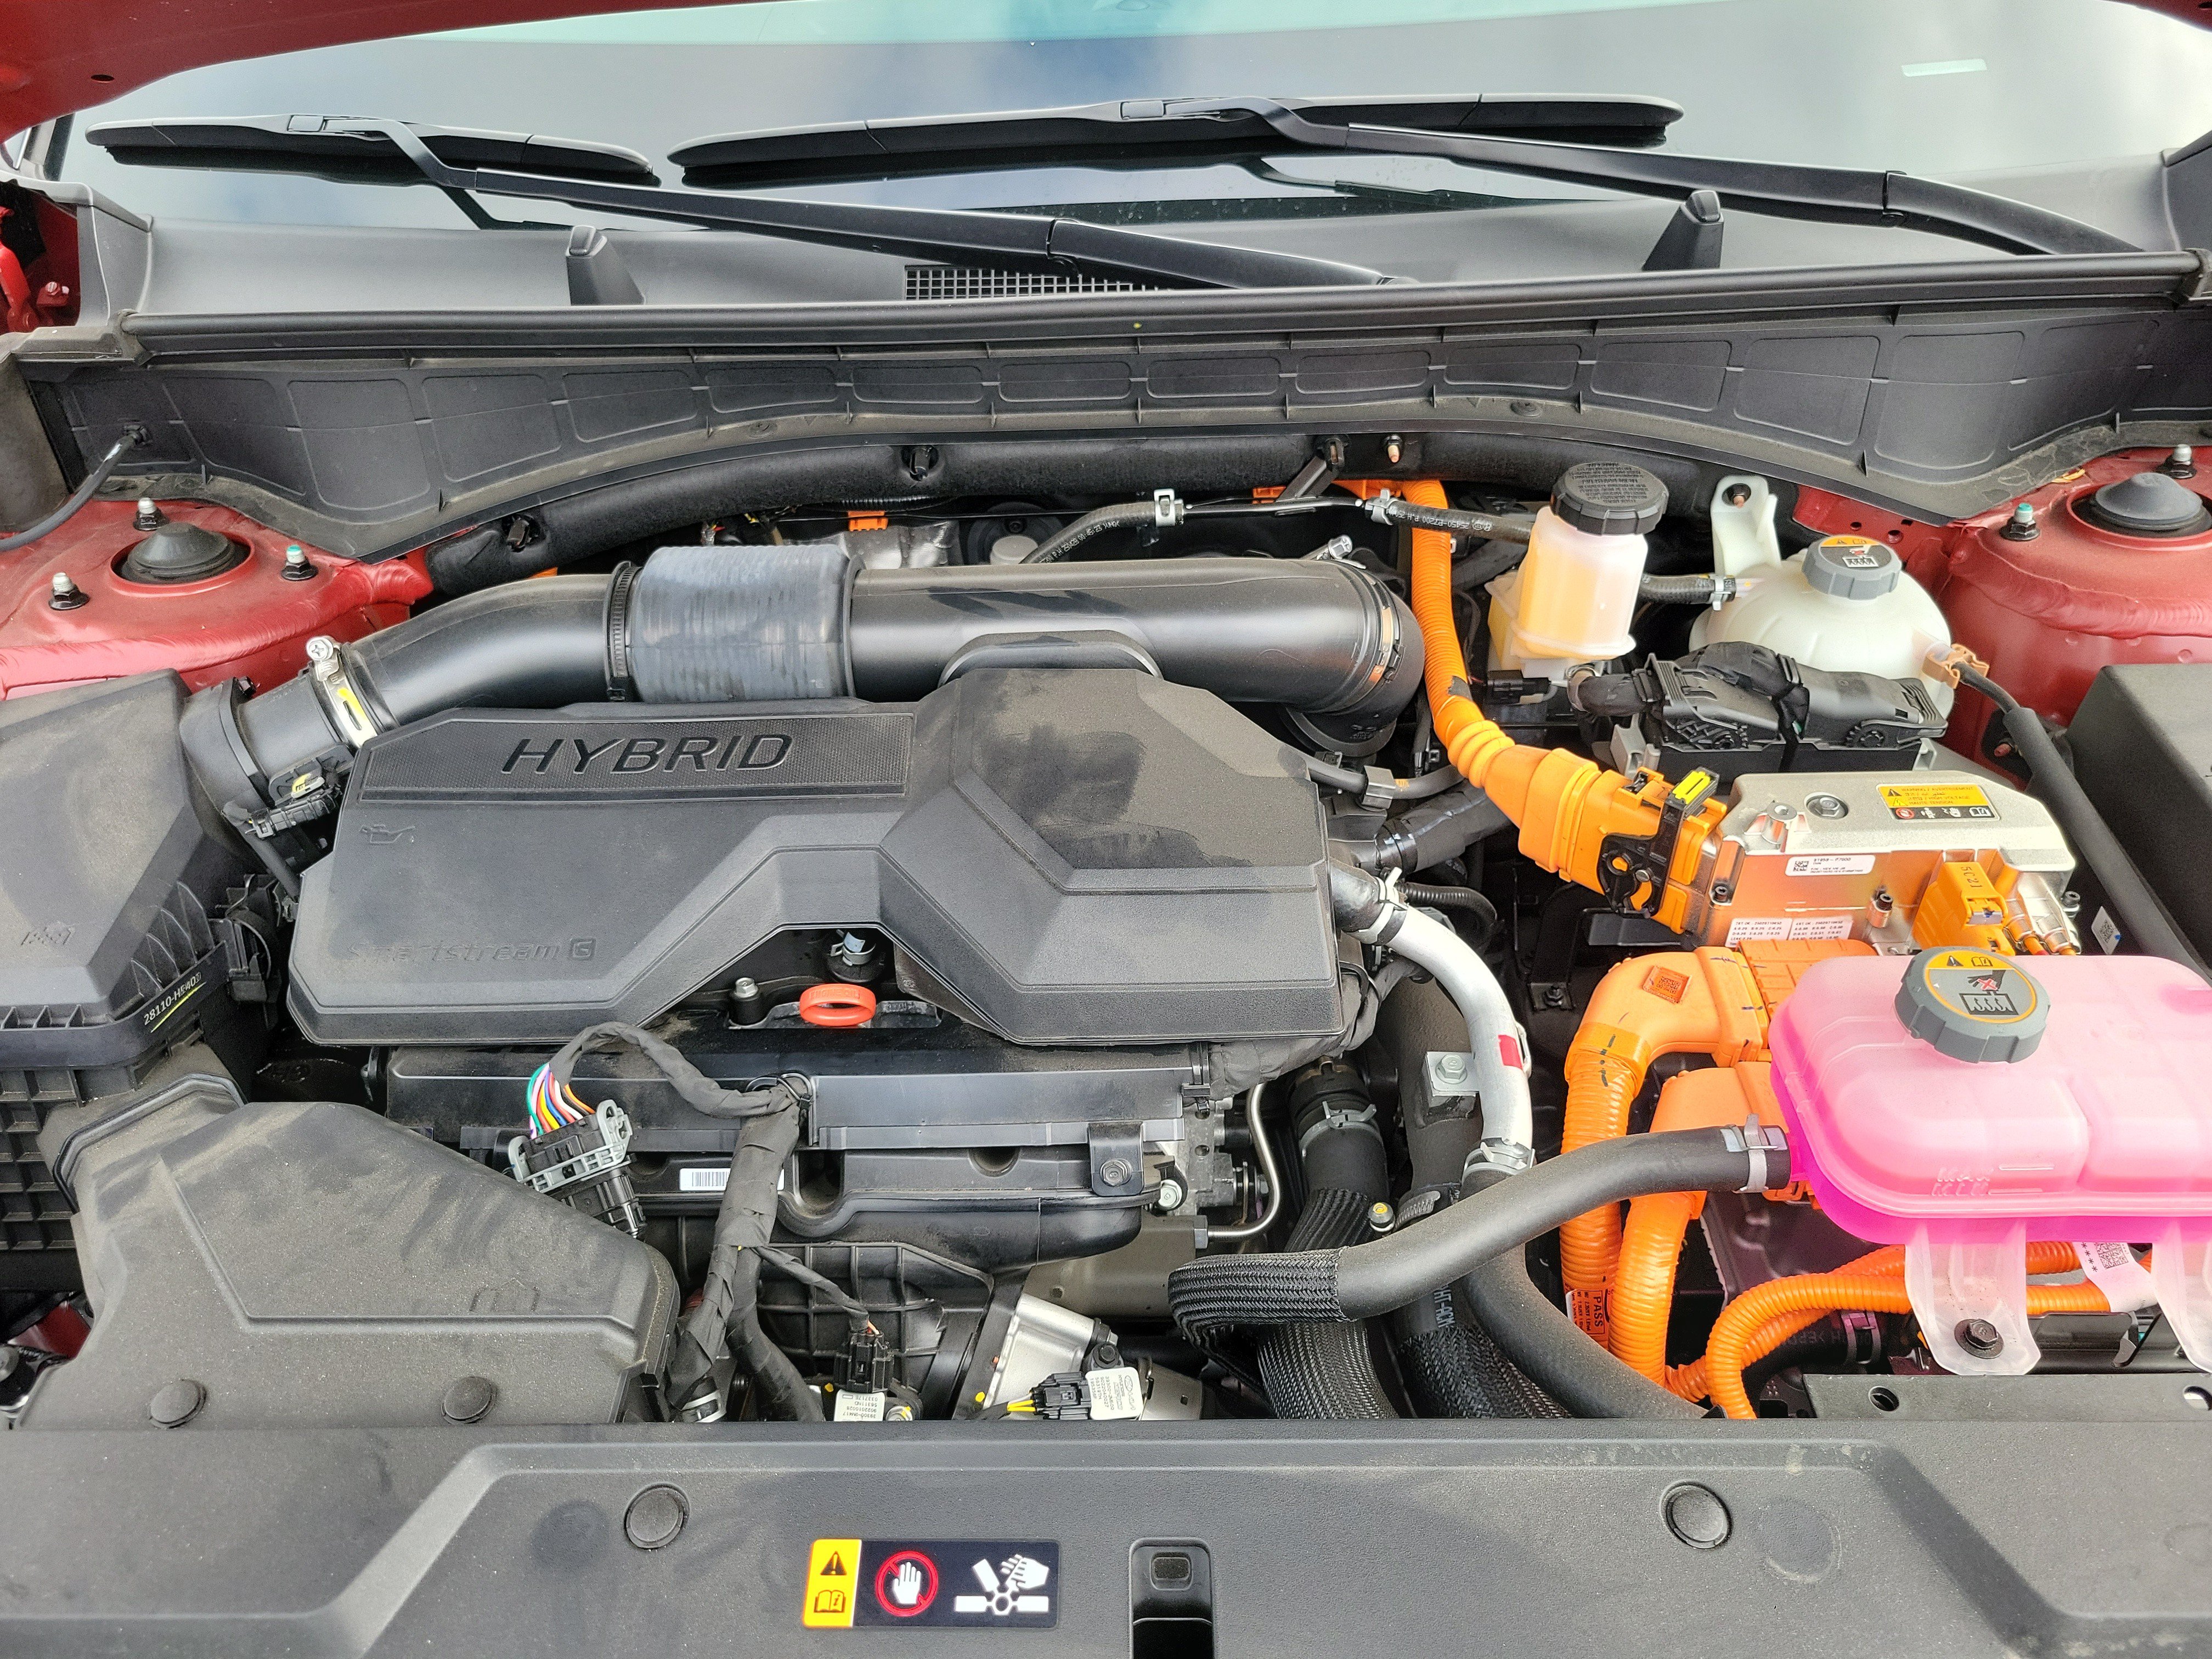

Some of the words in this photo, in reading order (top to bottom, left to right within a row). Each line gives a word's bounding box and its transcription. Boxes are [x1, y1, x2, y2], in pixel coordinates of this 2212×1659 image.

[502, 732, 793, 775] HYBRID
[1960, 866, 1983, 888] 5C21
[347, 941, 562, 962] Smartstream
[809, 989, 842, 1000] ENGINE
[843, 988, 861, 1000] OIL
[1593, 1296, 1603, 1327] PASS
